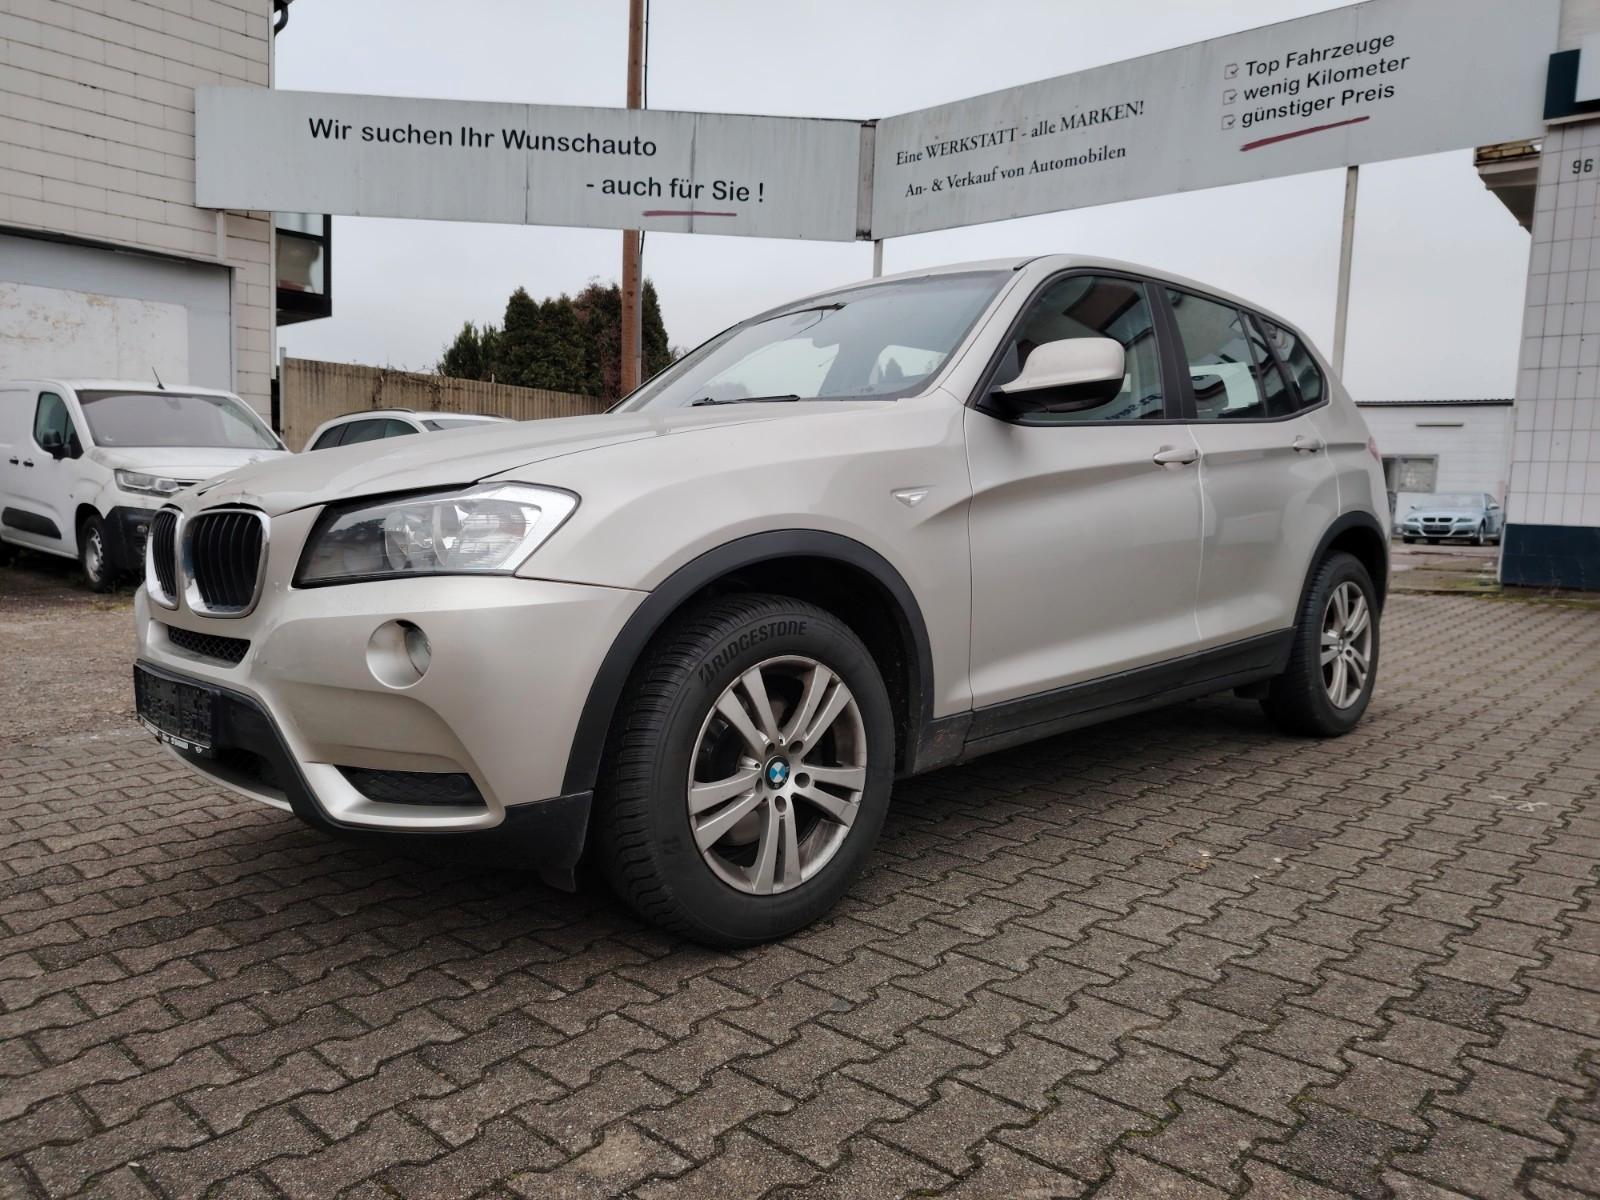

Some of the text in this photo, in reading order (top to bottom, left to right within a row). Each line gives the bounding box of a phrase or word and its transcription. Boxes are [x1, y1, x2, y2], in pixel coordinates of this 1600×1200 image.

[1245, 34, 1395, 77] Top Fahrzeuge
[1244, 56, 1410, 101] wenig Kilometer
[1241, 83, 1395, 128] günstiger Preis
[308, 117, 657, 156] Wir suchen Ihr Wunschauto
[896, 151, 923, 166] Eine
[925, 127, 1018, 159] WERKSTATT
[1031, 119, 1056, 138] alle
[1060, 100, 1144, 132] MARKEN!
[601, 176, 662, 198] auch
[668, 177, 705, 200] für
[711, 179, 750, 202] Sie
[905, 145, 1126, 198] An- & Verkauf von Automobilen
[1572, 158, 1594, 175] 96
[698, 620, 808, 687] BRIDGESTONE
